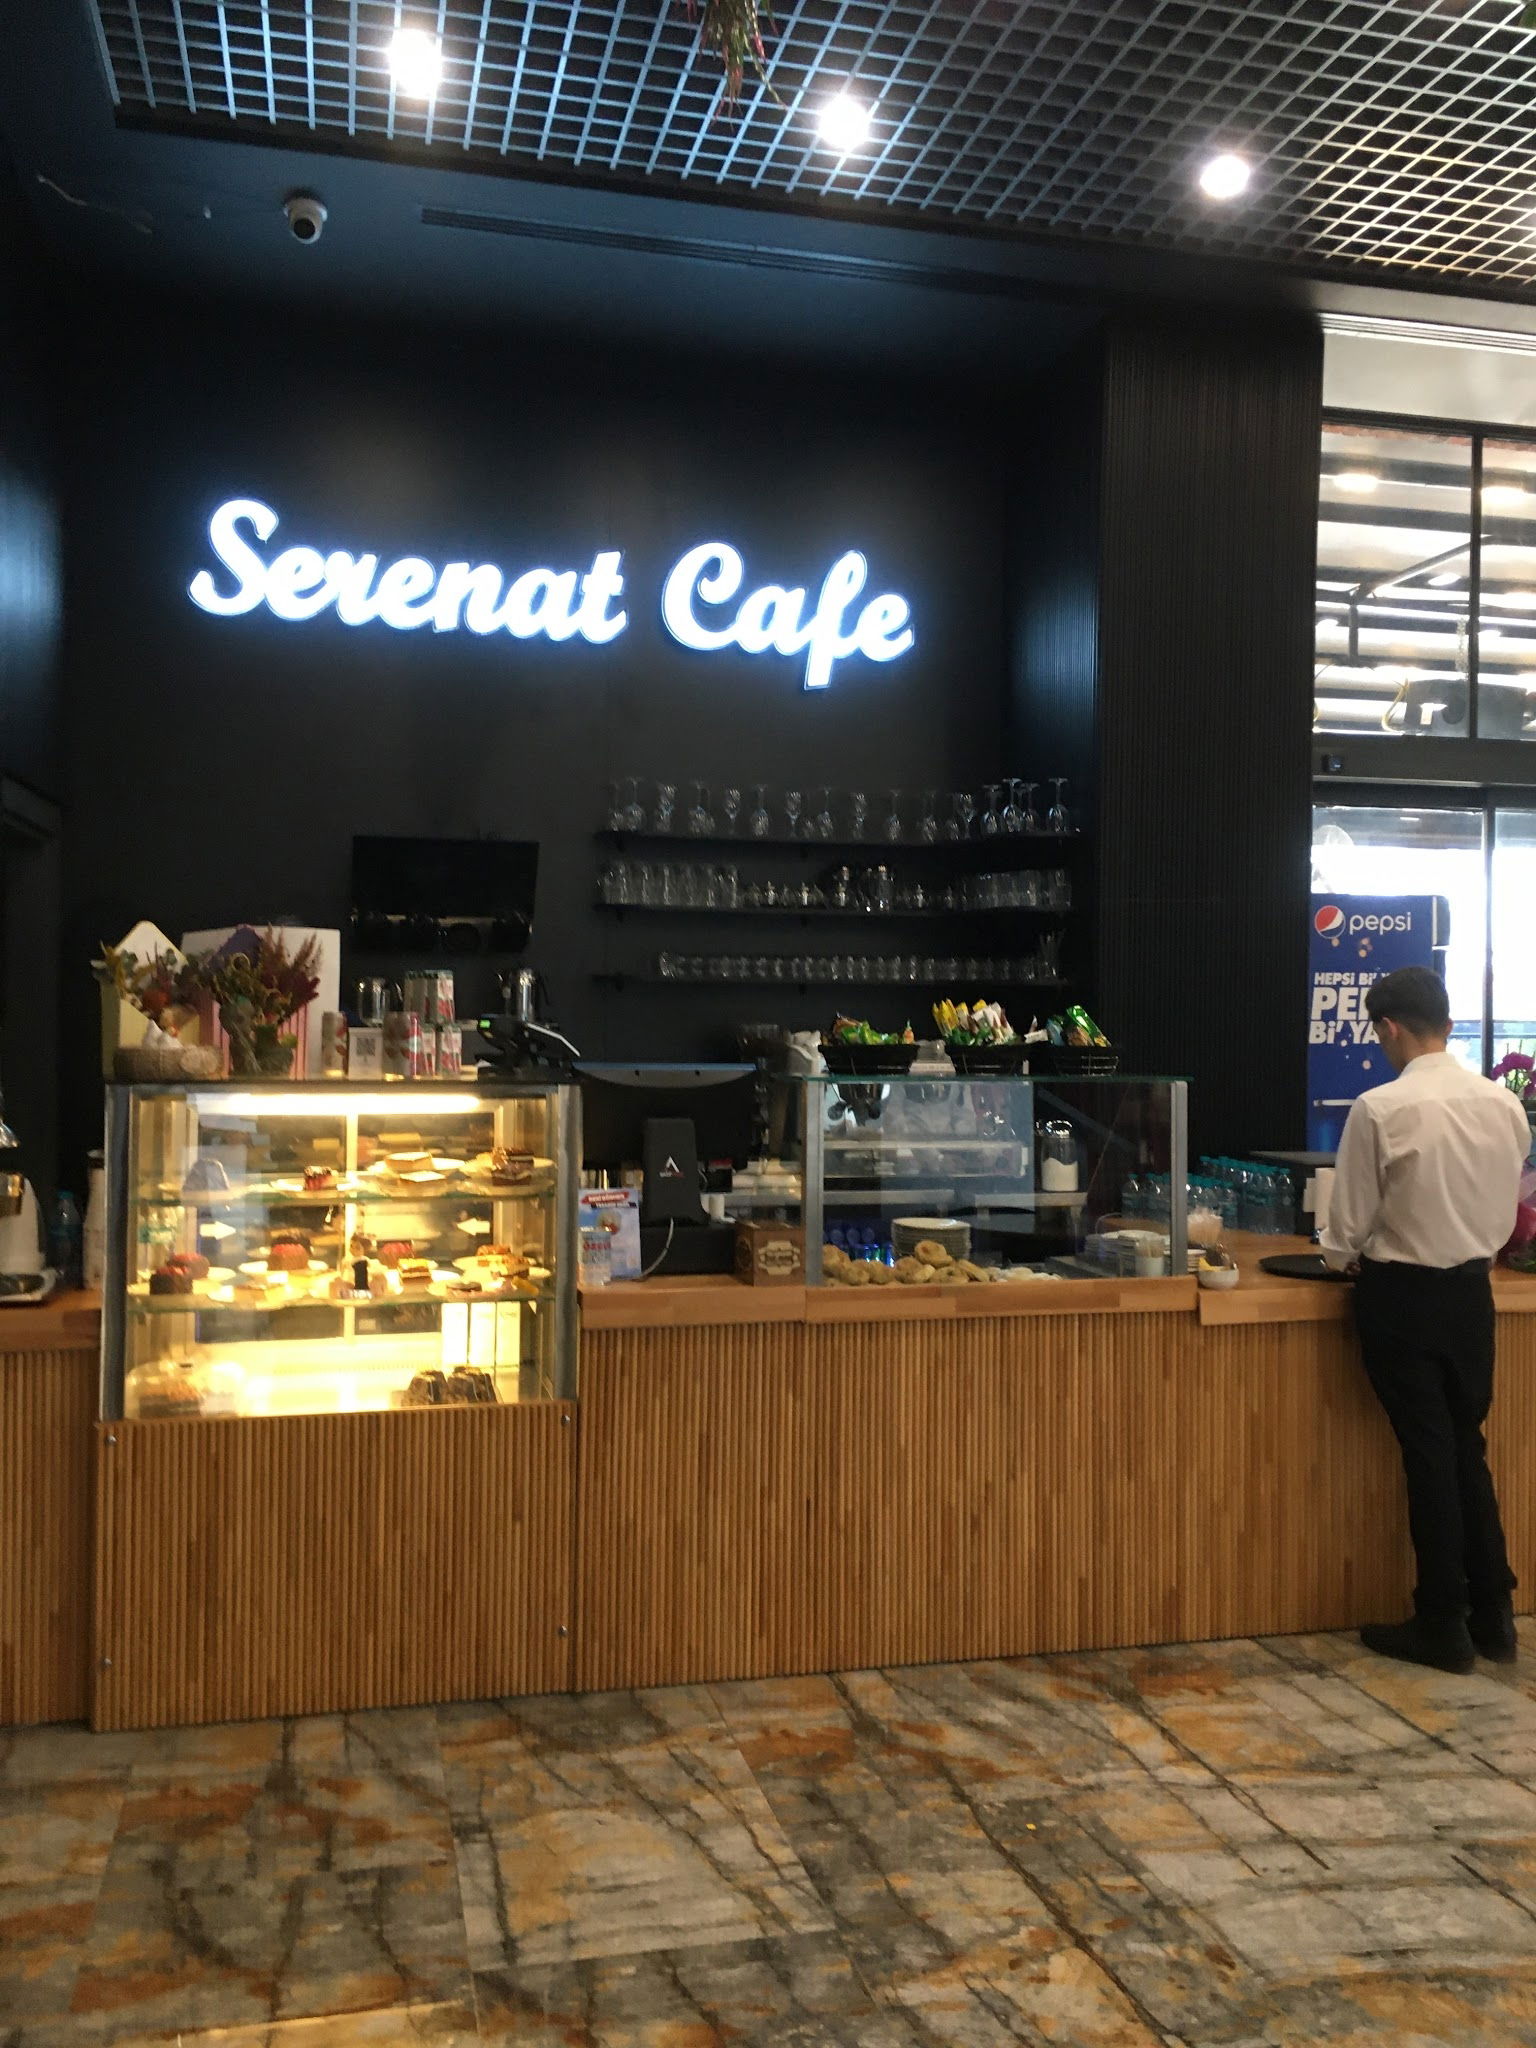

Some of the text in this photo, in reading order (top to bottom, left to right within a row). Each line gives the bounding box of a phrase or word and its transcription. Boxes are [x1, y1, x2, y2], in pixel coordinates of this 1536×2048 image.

[188, 498, 914, 690] Serenat Cafe
[1350, 911, 1412, 935] pepsi
[1350, 1021, 1381, 1044] YA
